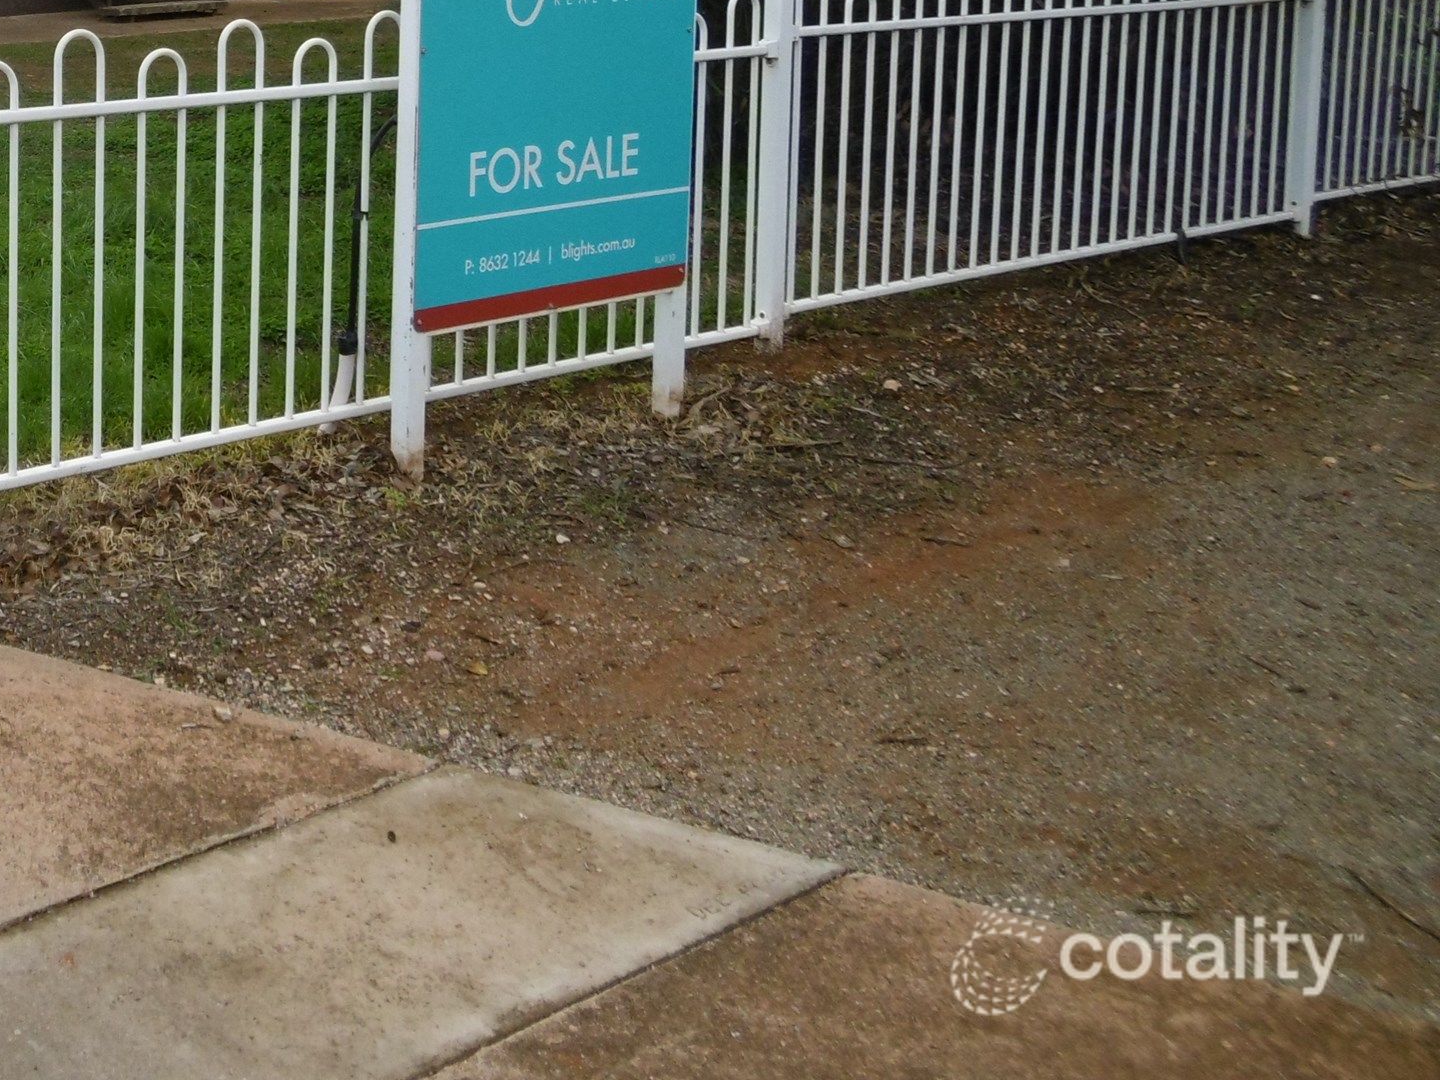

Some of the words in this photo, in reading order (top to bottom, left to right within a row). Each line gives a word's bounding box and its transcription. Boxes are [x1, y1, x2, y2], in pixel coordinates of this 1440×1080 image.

[468, 144, 544, 198] FOR
[555, 132, 640, 186] SALE
[478, 253, 509, 274] 8632
[512, 248, 541, 268] 1244
[560, 237, 636, 262] blights.com.au
